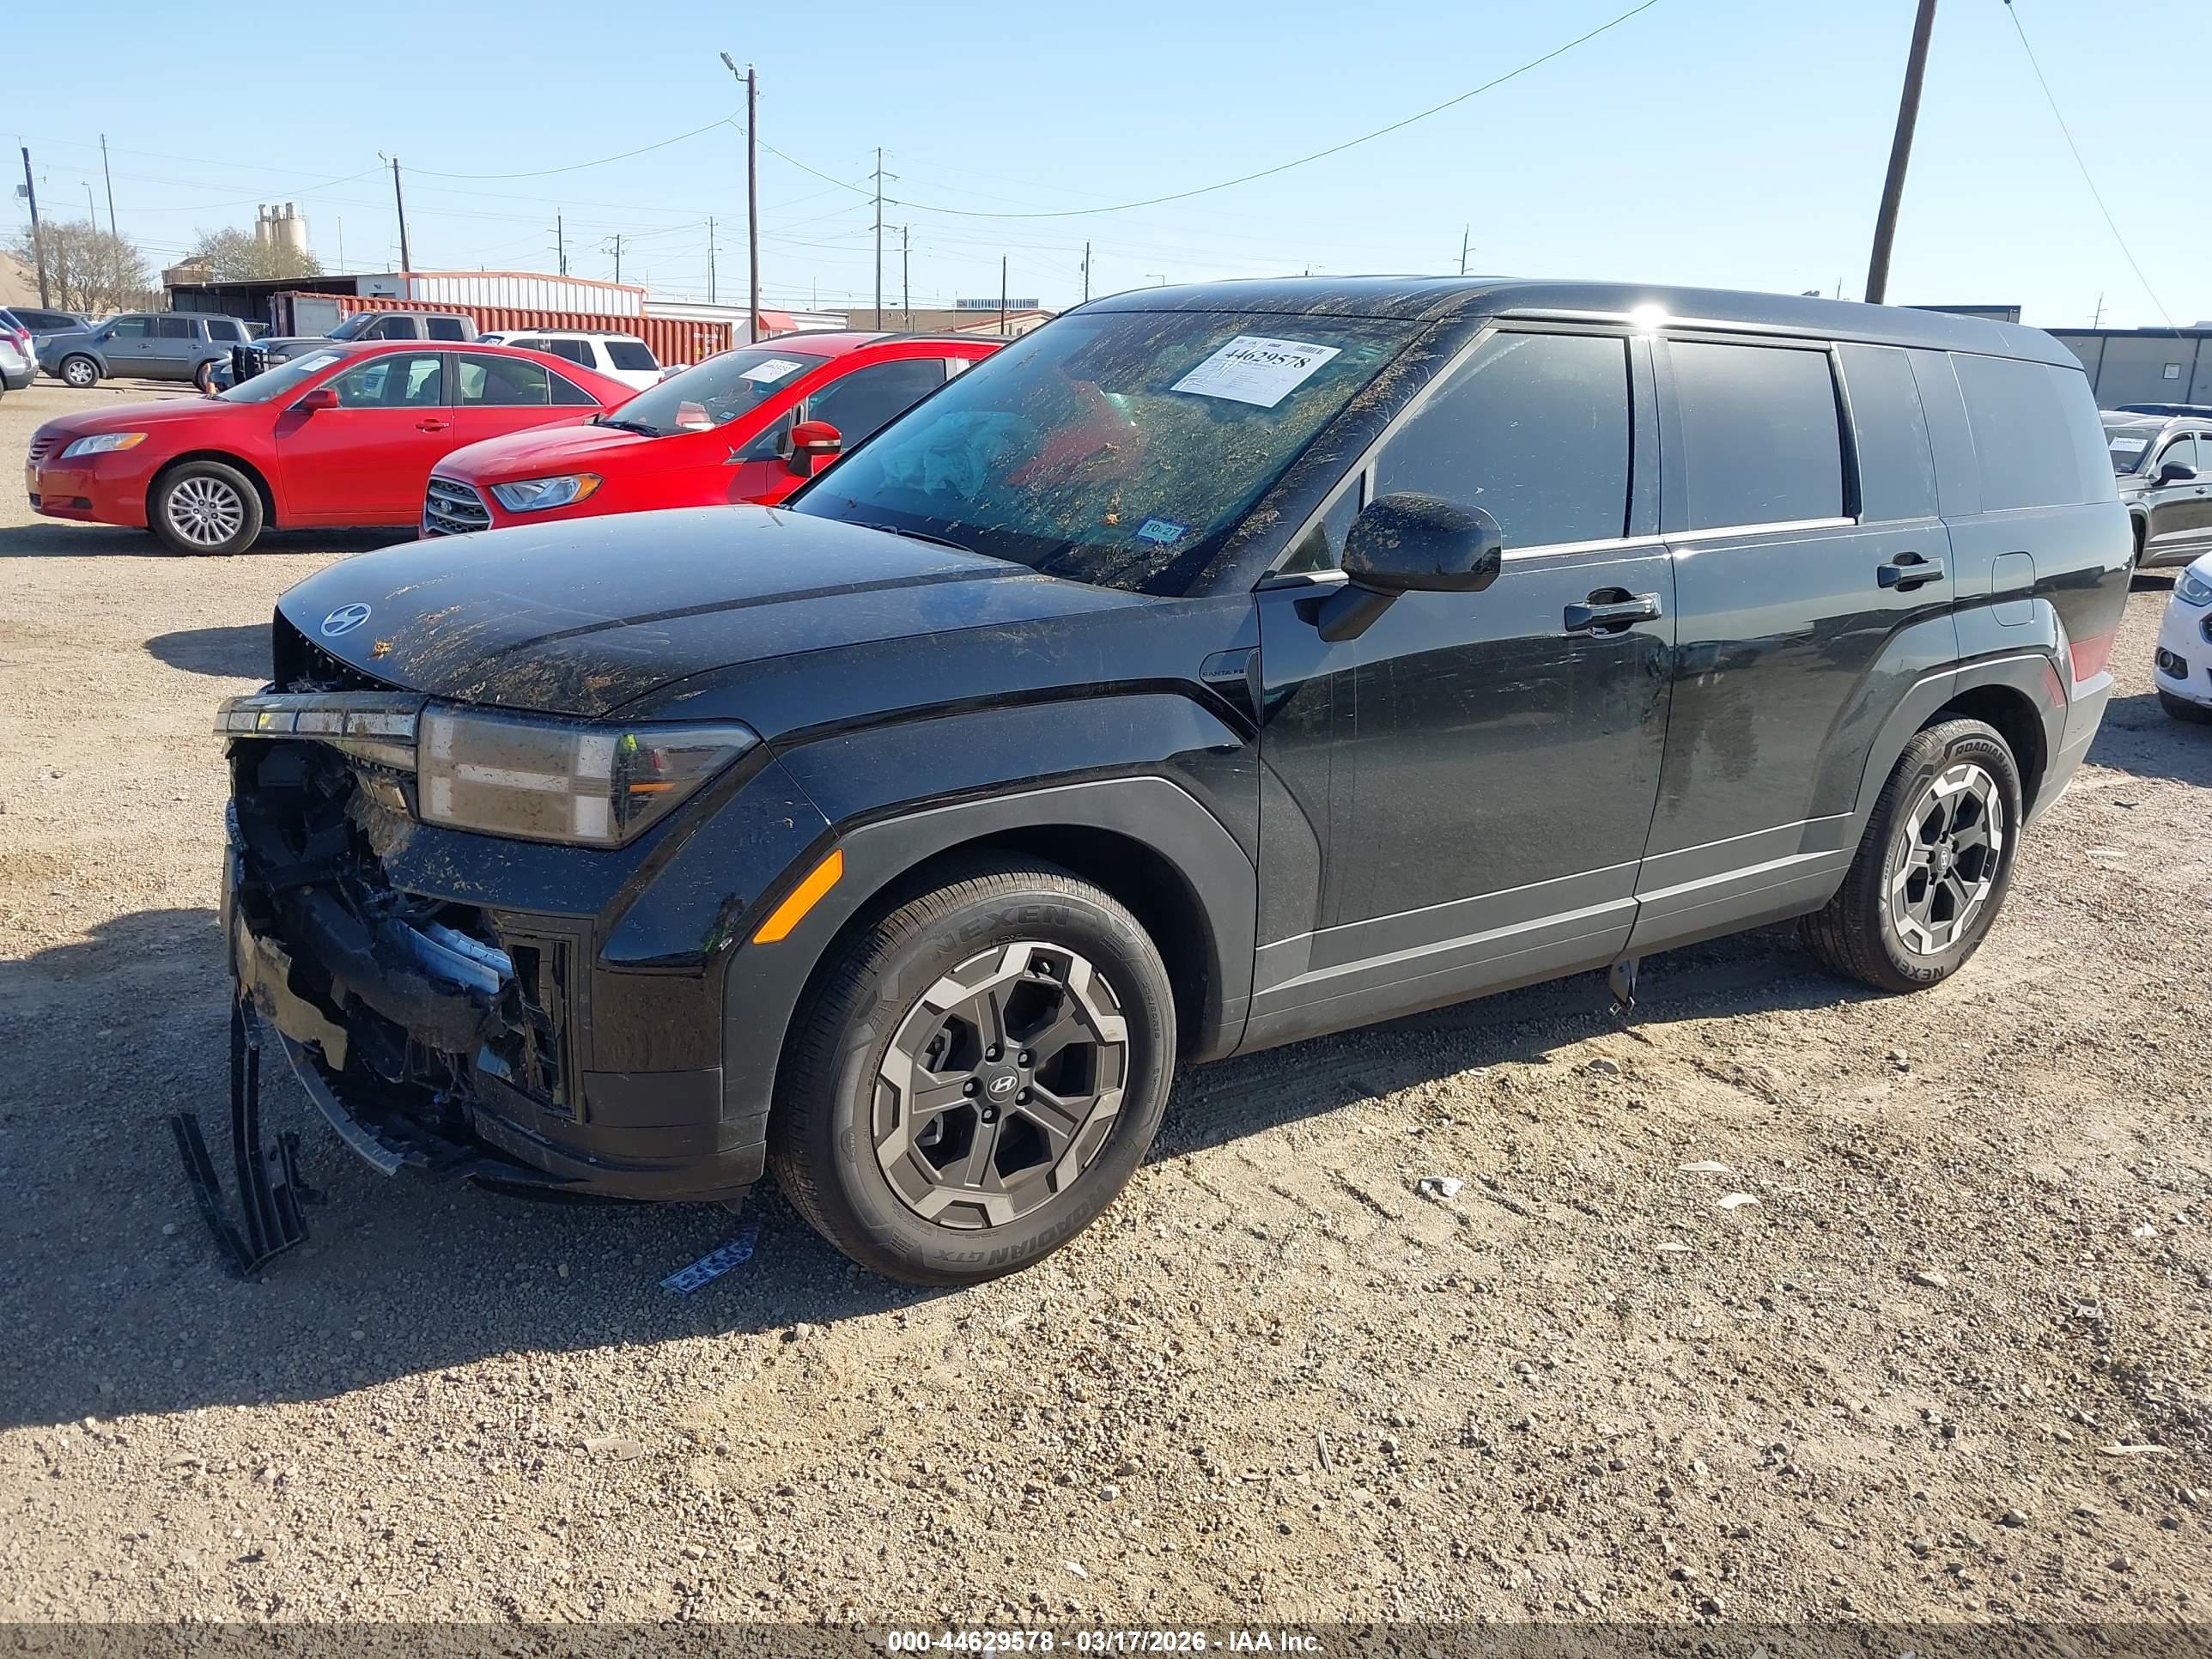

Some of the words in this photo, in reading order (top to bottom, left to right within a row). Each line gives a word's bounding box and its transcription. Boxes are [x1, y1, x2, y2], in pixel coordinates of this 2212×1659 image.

[1224, 349, 1312, 369] 44629578
[1201, 670, 1231, 678] SANTA
[1955, 742, 2005, 763] ROADIAN
[931, 905, 1070, 962] NEXEN
[1892, 952, 1944, 980] NEXEN
[988, 1184, 1106, 1266] ROADIAN
[933, 1249, 985, 1263] GTX
